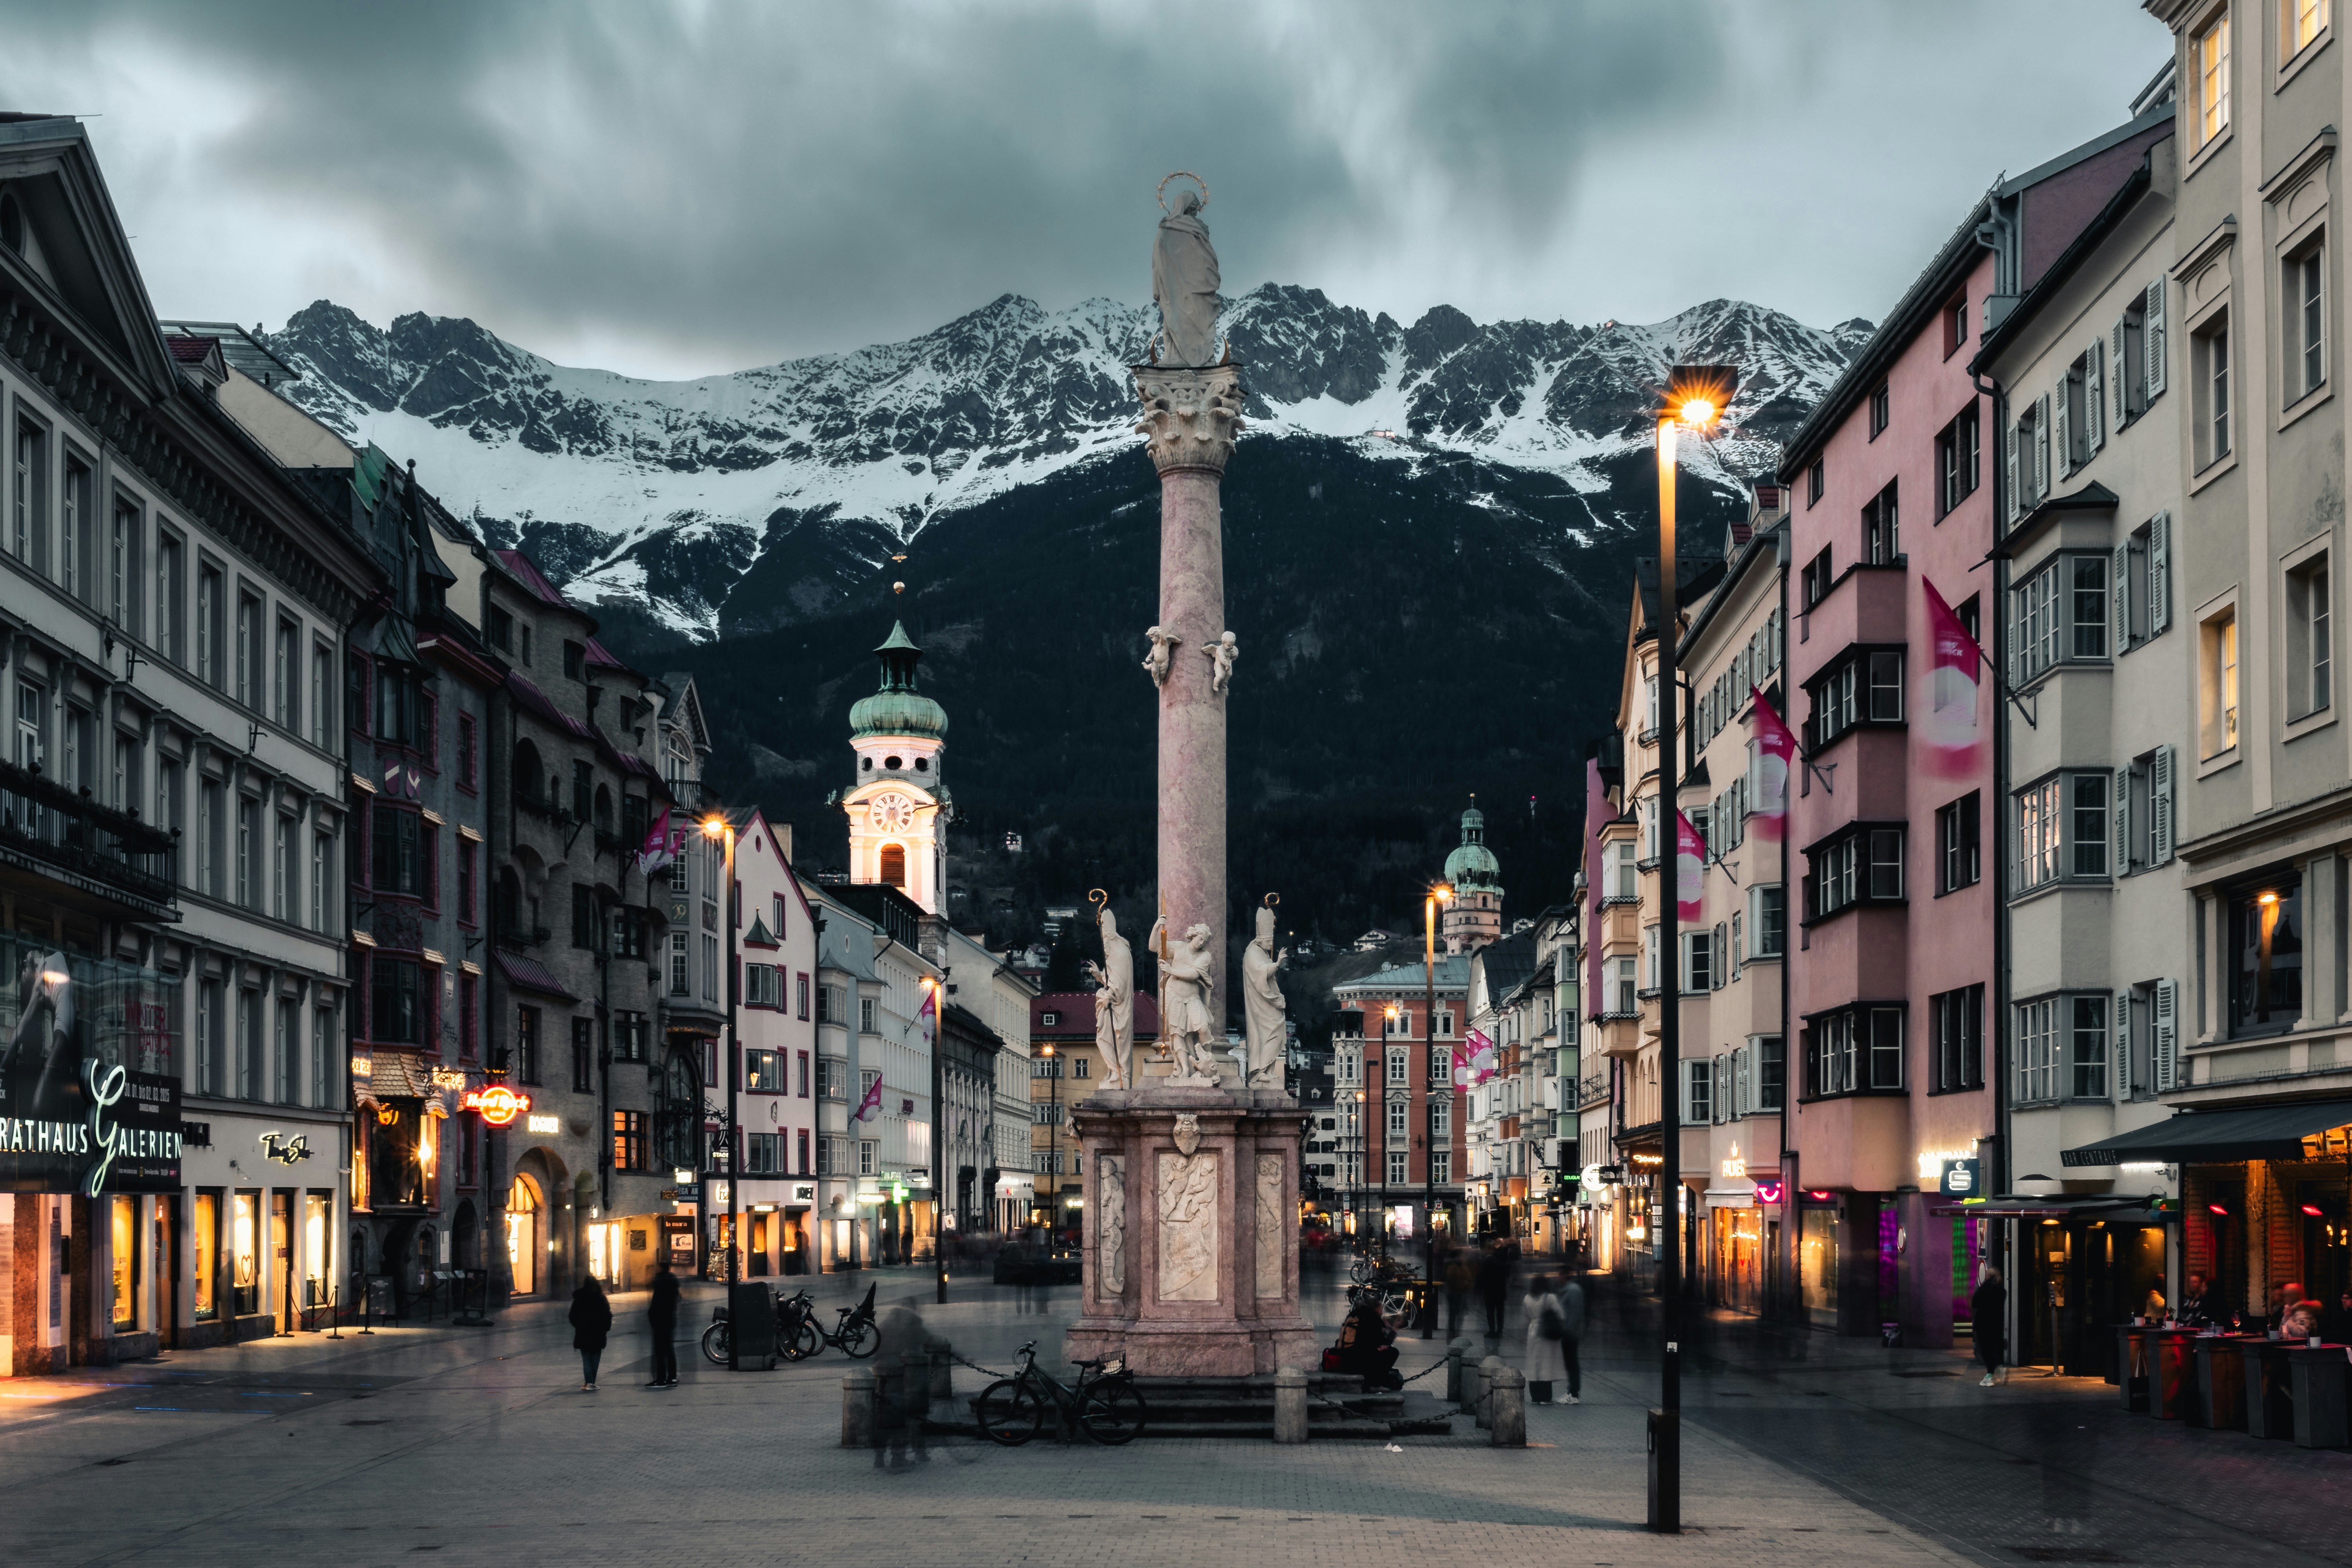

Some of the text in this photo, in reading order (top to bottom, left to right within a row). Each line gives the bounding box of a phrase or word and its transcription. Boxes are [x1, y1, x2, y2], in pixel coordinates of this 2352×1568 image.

[466, 1093, 529, 1111] Hard Rock
[0, 1118, 87, 1153] RATHAUS
[2063, 1150, 2117, 1166] BAR CENTRALE
[1722, 1159, 1745, 1177] PALMER
